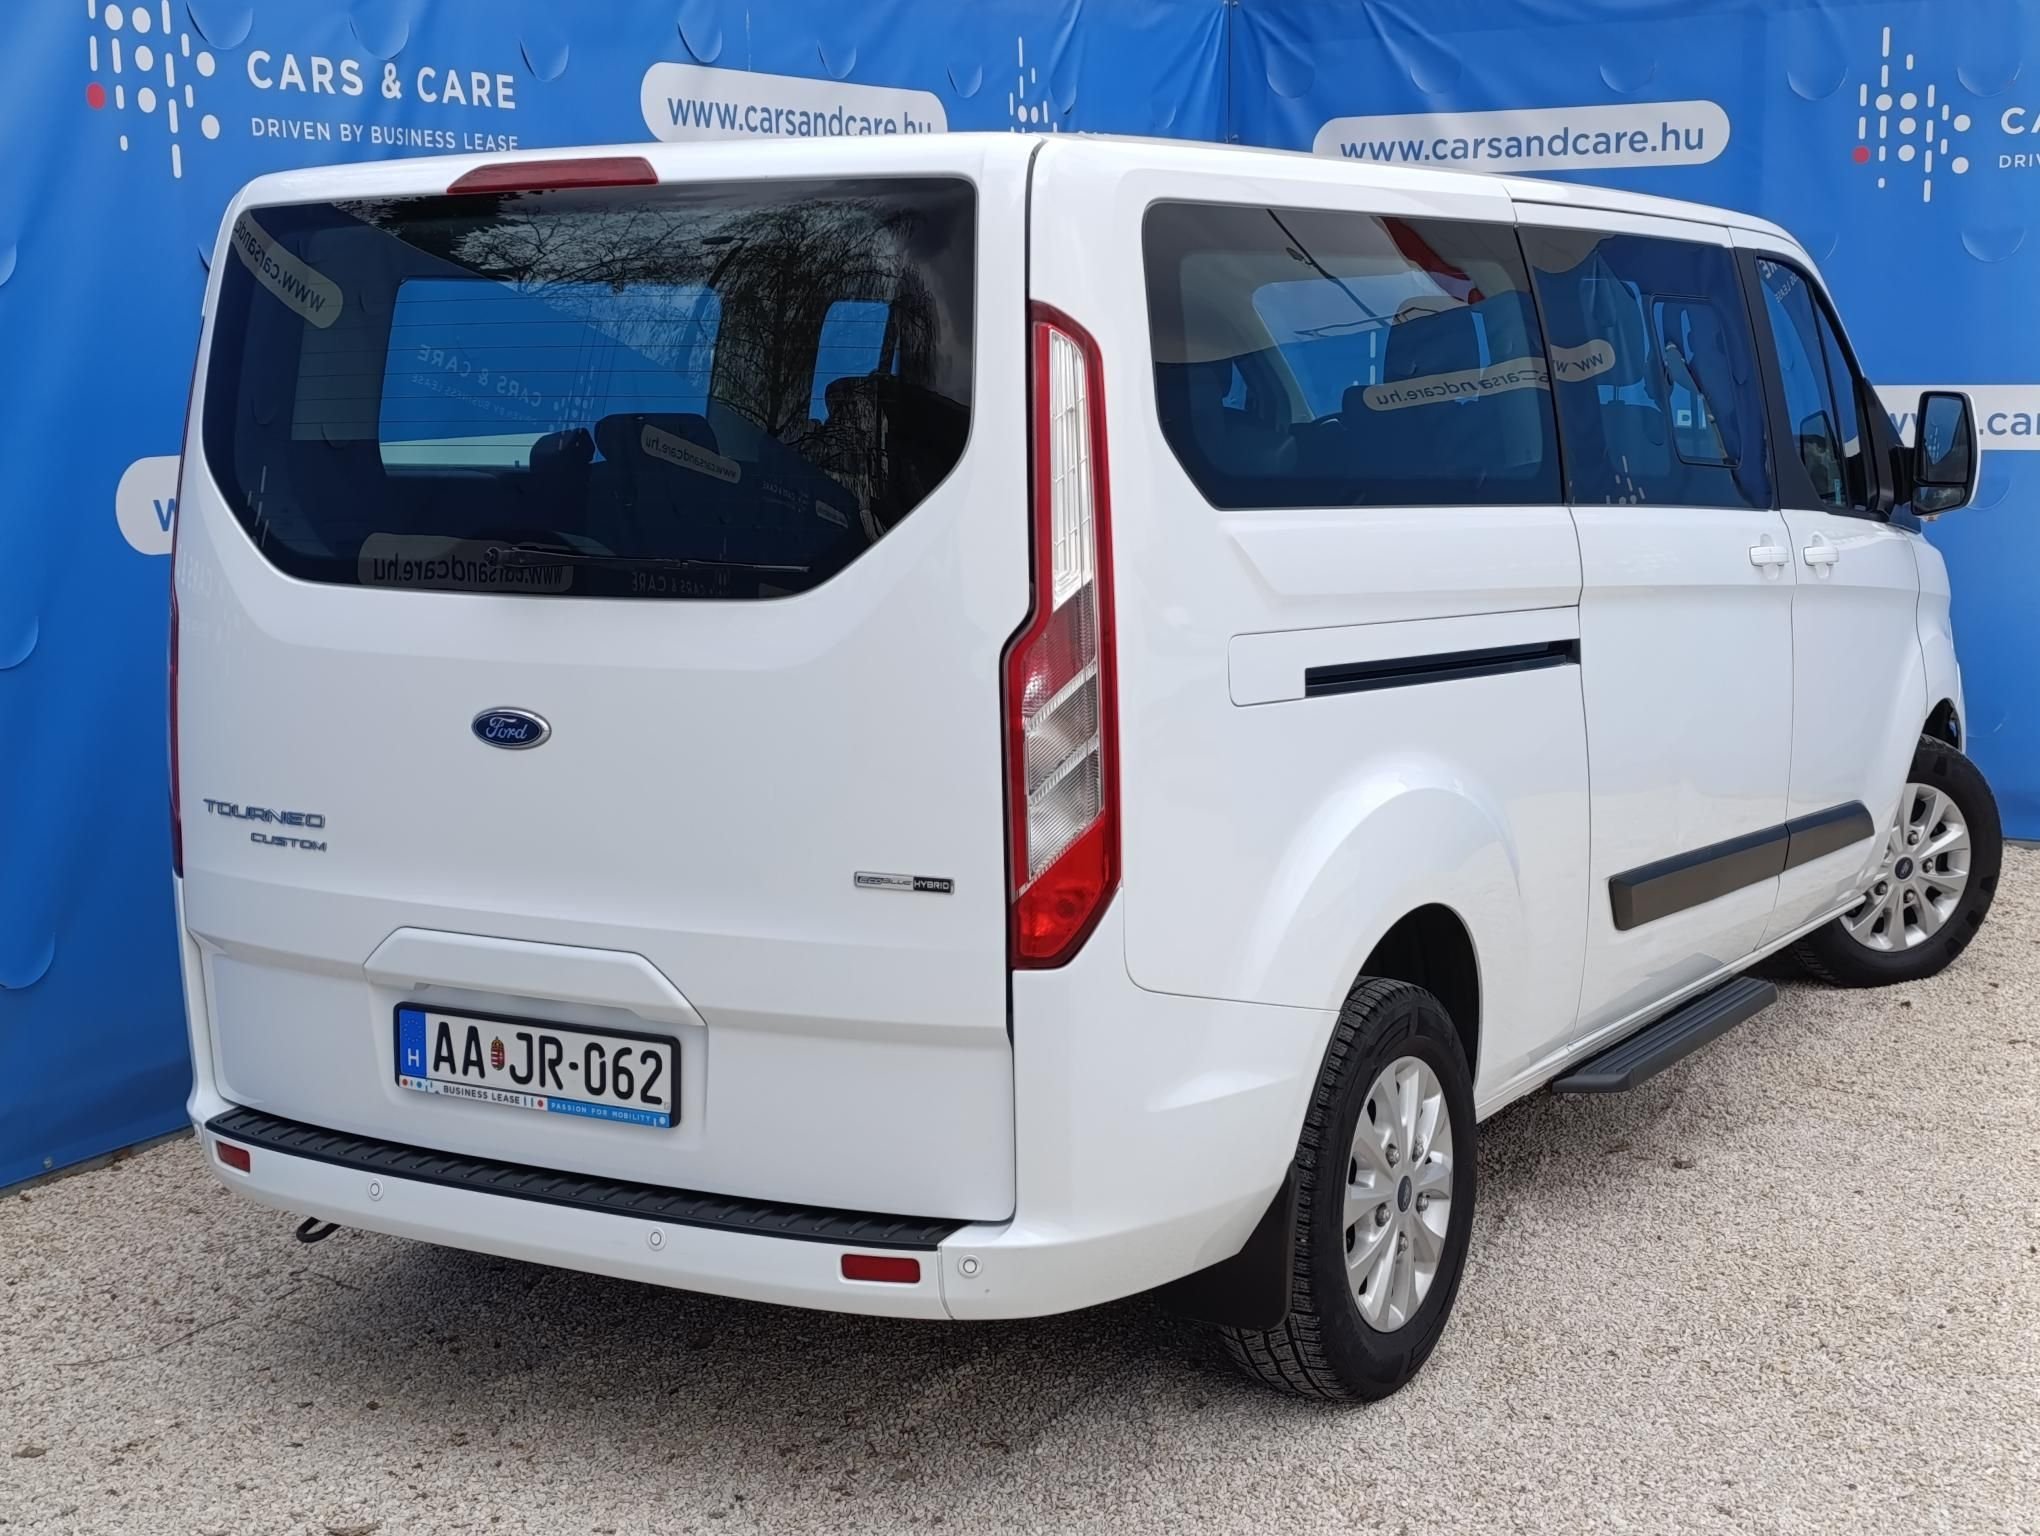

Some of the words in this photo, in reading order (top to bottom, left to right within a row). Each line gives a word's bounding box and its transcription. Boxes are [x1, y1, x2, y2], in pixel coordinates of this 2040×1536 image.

[247, 50, 364, 96] CARS
[381, 62, 402, 99] &
[417, 66, 516, 109] CARE
[667, 97, 932, 136] www.carsandcareh
[251, 117, 331, 141] DRIVEN
[340, 123, 364, 143] BY
[371, 126, 456, 149] BUSINESS
[463, 132, 519, 151] LEASE
[1340, 122, 1704, 162] www.carsandcare.hu
[486, 716, 529, 740] Ford
[203, 798, 325, 829] TOURNEO
[251, 832, 327, 853] CUSTOM
[914, 879, 950, 891] HYBRID
[407, 1047, 420, 1068] H
[433, 1021, 485, 1079] AA
[509, 1032, 663, 1105] JR-062
[443, 1084, 489, 1100] BUSINESS
[491, 1091, 521, 1105] LEASE
[551, 1101, 587, 1114] PASSION
[591, 1107, 608, 1117] FOR
[612, 1110, 651, 1123] MOBILITY
